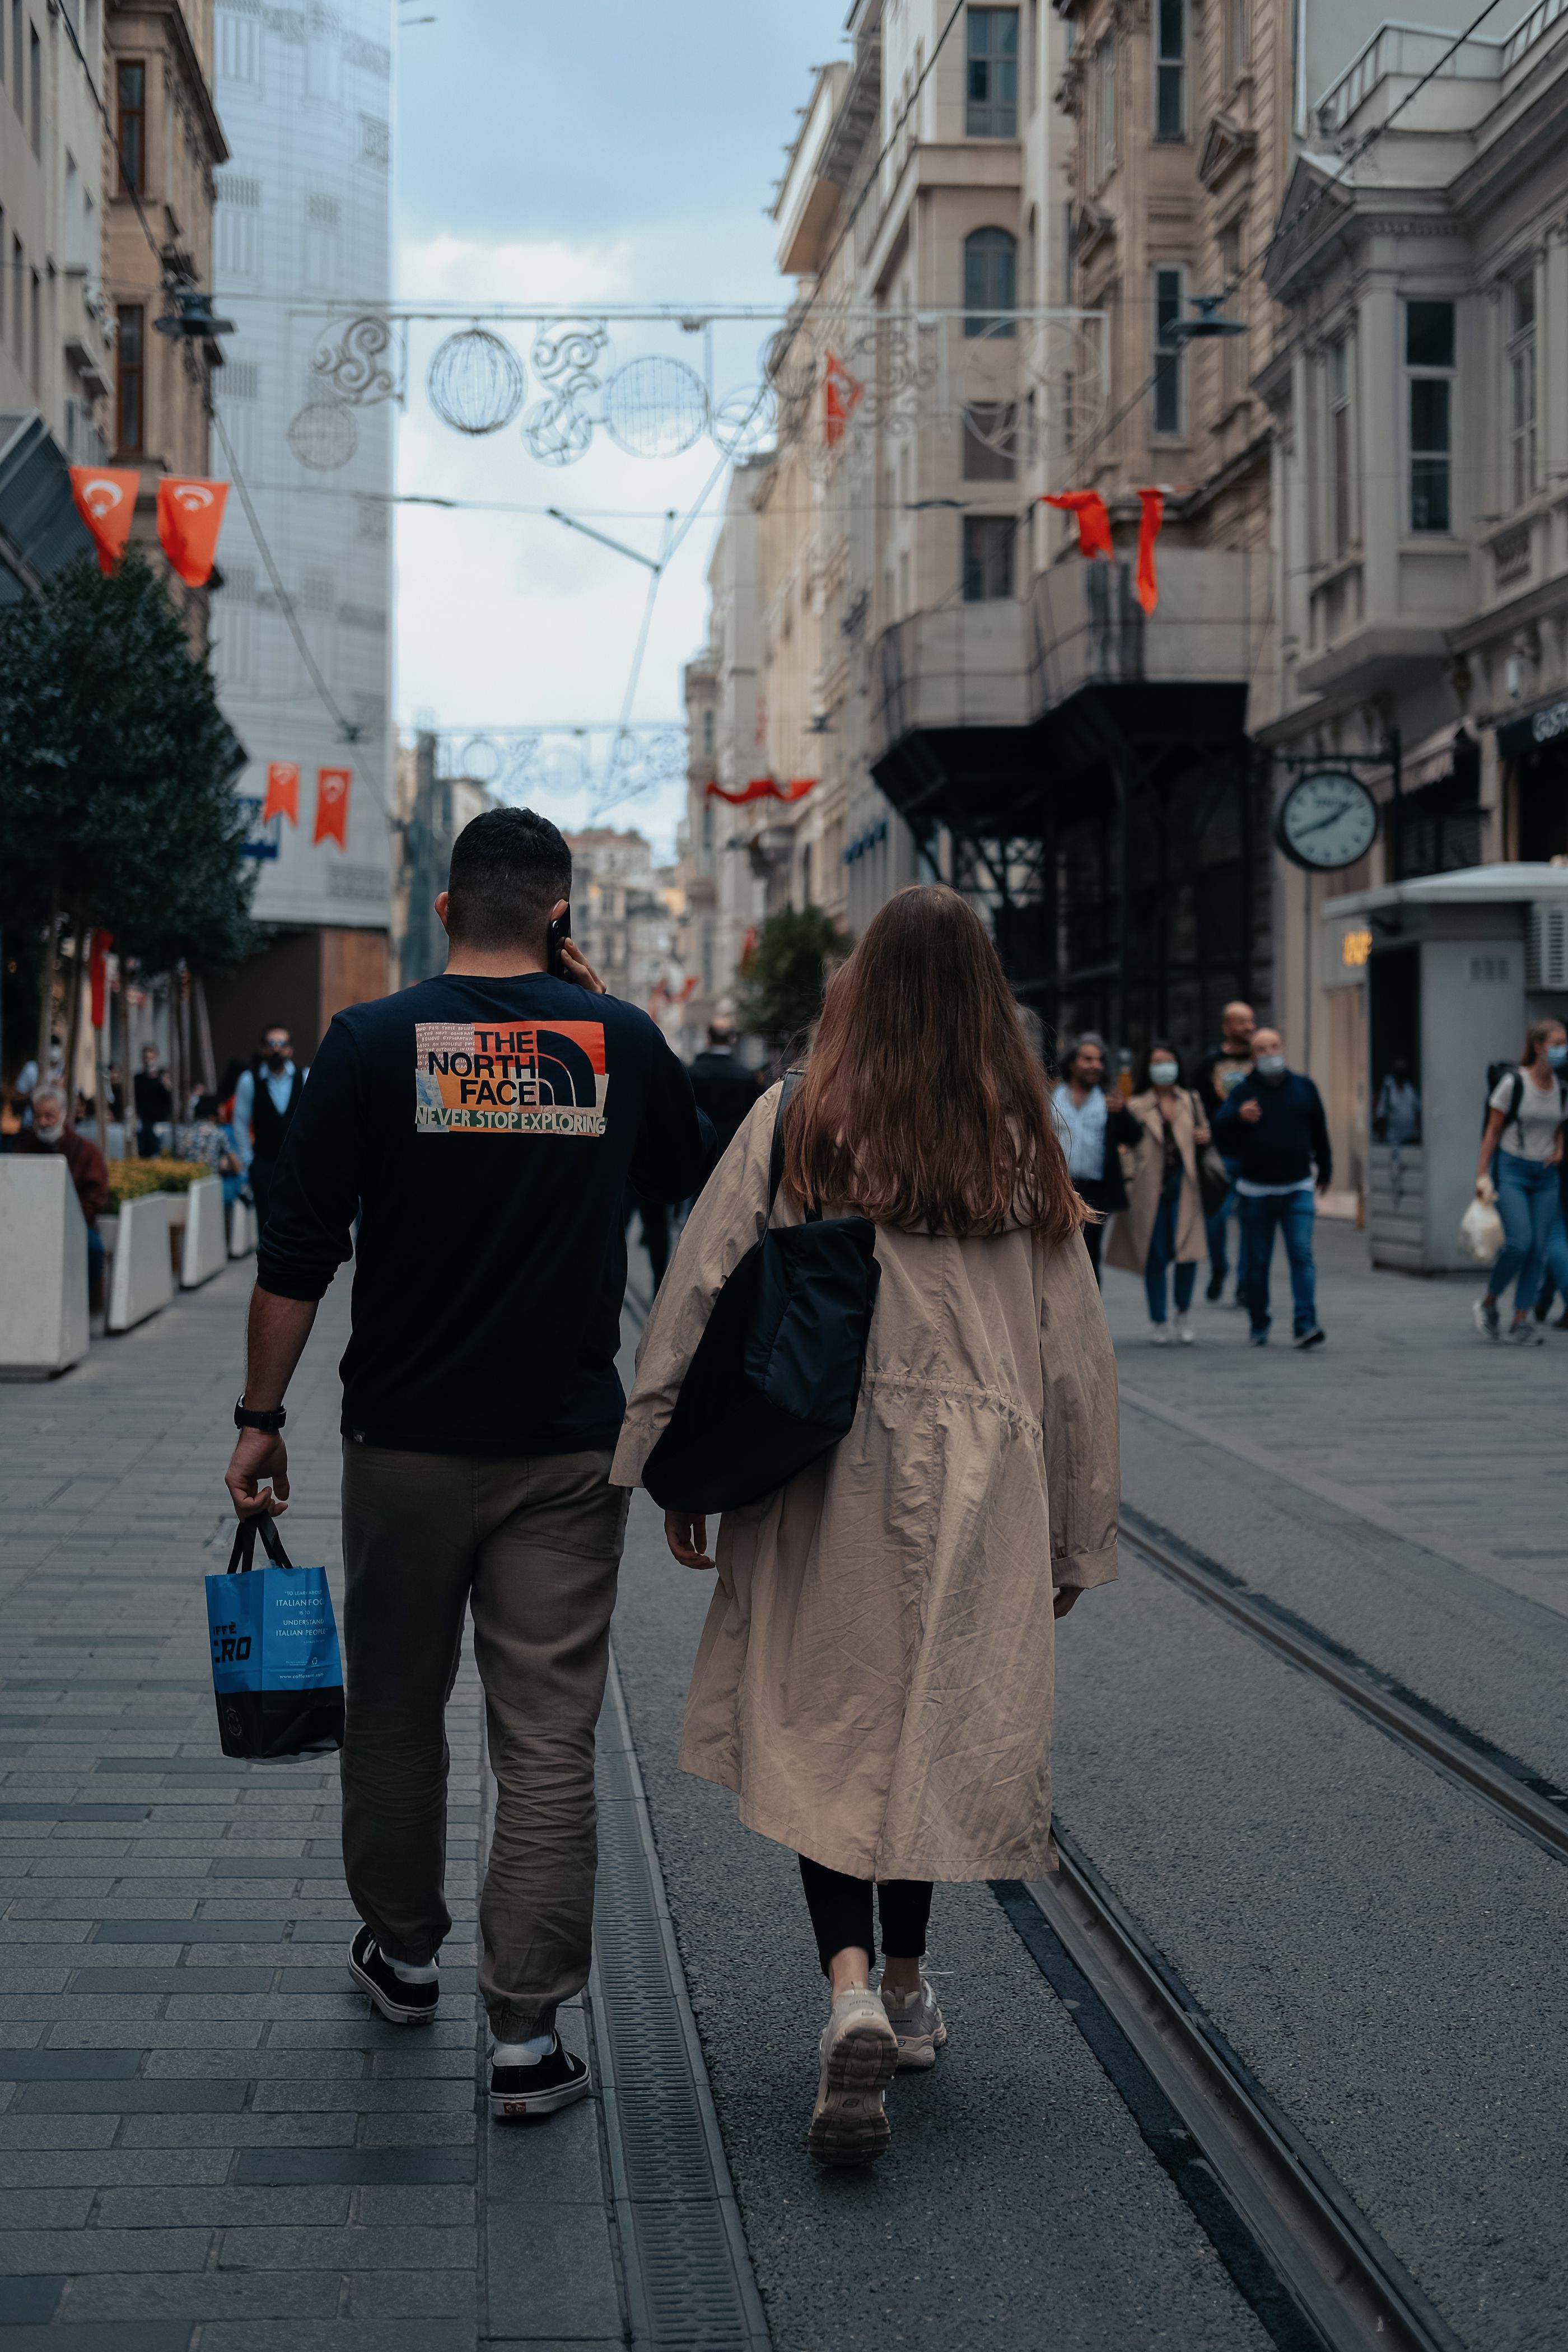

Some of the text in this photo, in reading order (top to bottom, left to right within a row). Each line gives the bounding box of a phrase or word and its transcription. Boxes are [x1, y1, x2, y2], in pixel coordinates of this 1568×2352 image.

[474, 1031, 534, 1053] THE
[428, 1051, 536, 1079] NORTH
[460, 1079, 537, 1106] FACE
[416, 1107, 608, 1135] NEVER STOP EXPLORING
